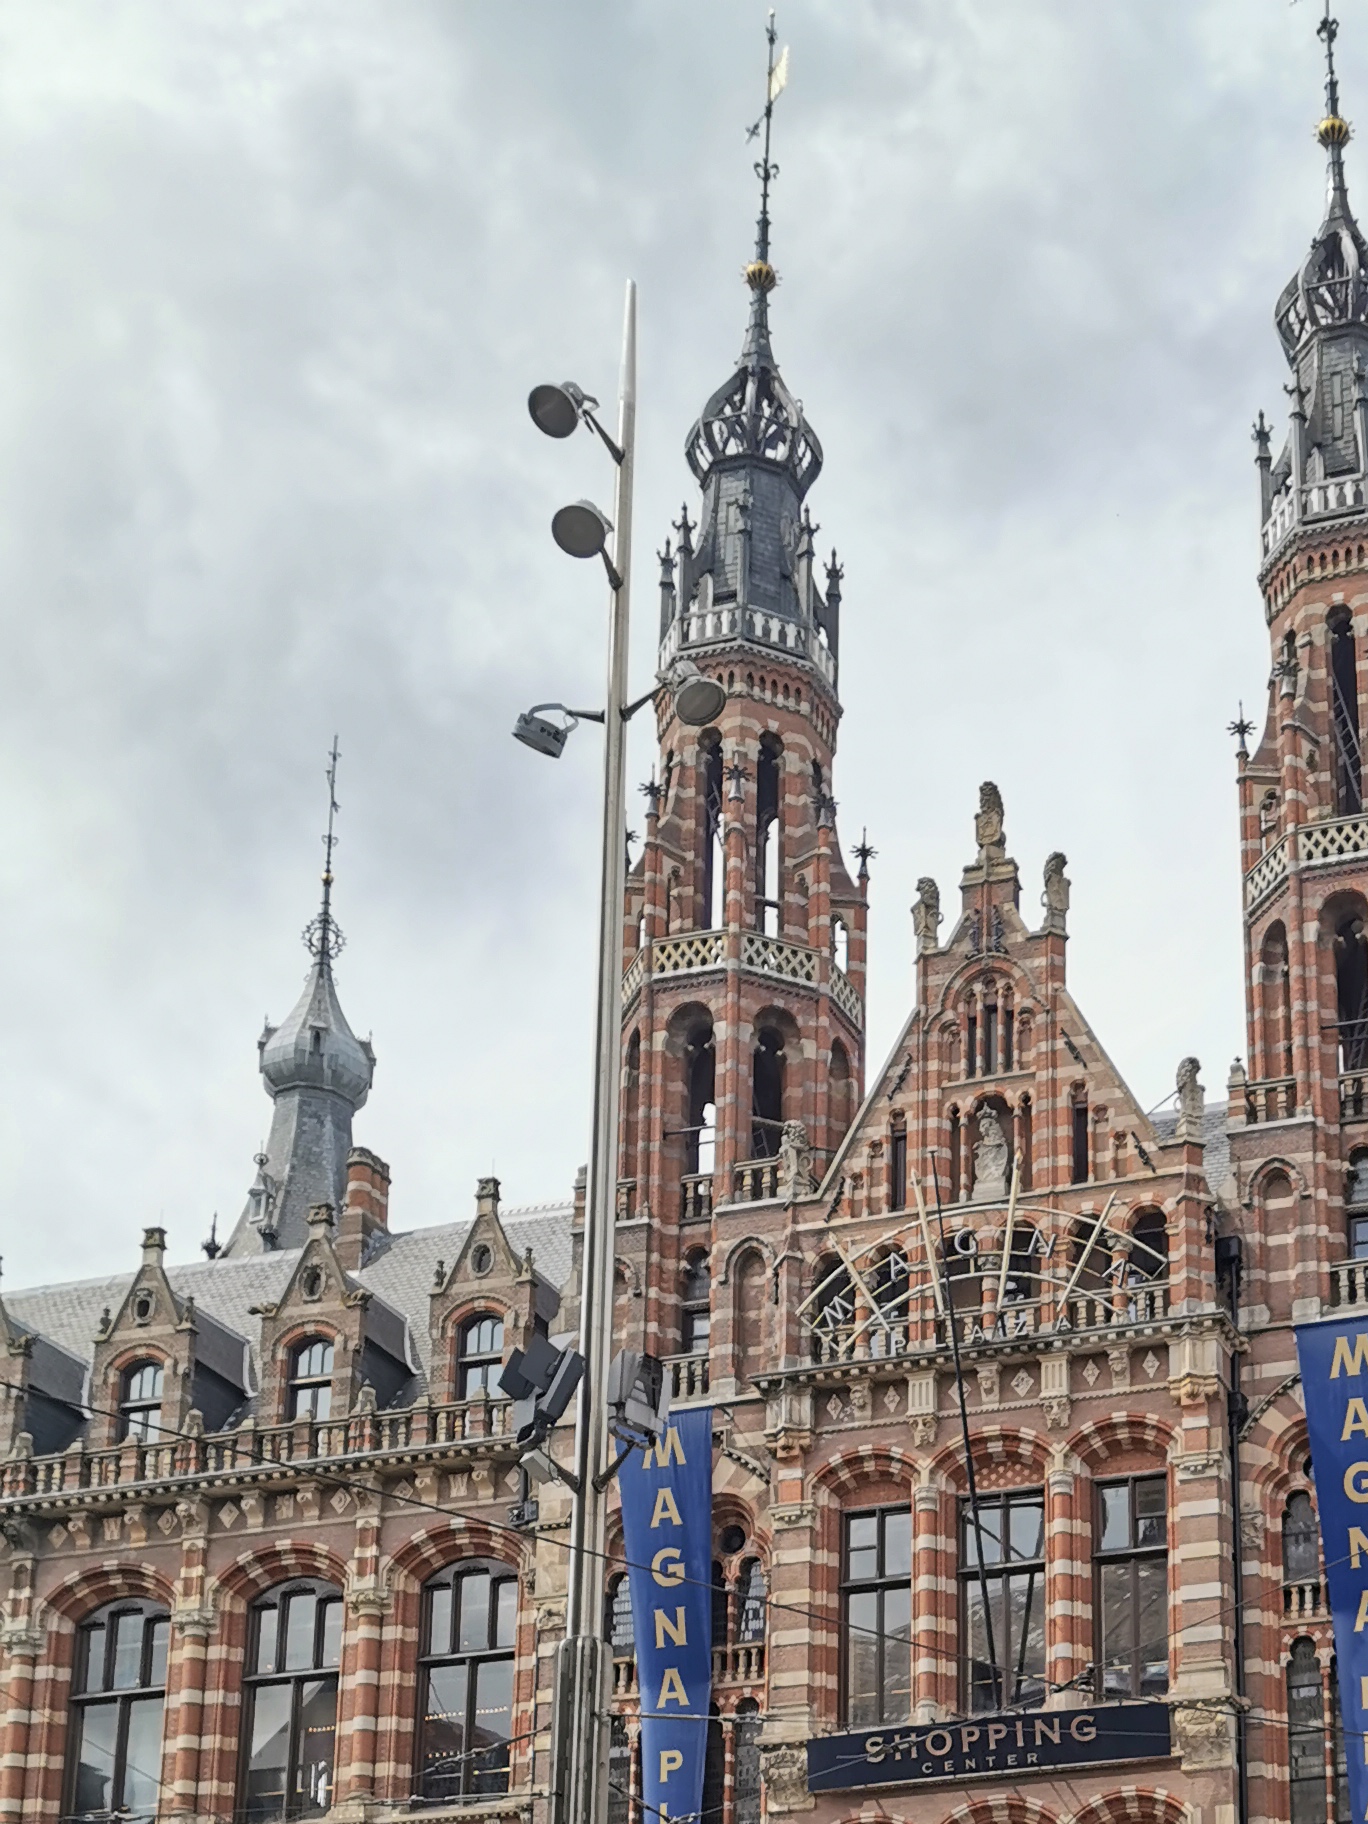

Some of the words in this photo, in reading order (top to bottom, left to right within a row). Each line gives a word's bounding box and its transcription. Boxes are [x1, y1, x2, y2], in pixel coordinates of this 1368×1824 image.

[820, 1227, 1132, 1332] MAGNA
[889, 1312, 1074, 1356] PLAZA
[642, 1426, 691, 1709] MAGNA
[865, 1714, 1098, 1764] SHOPPING
[921, 1752, 1039, 1774] CENTER
